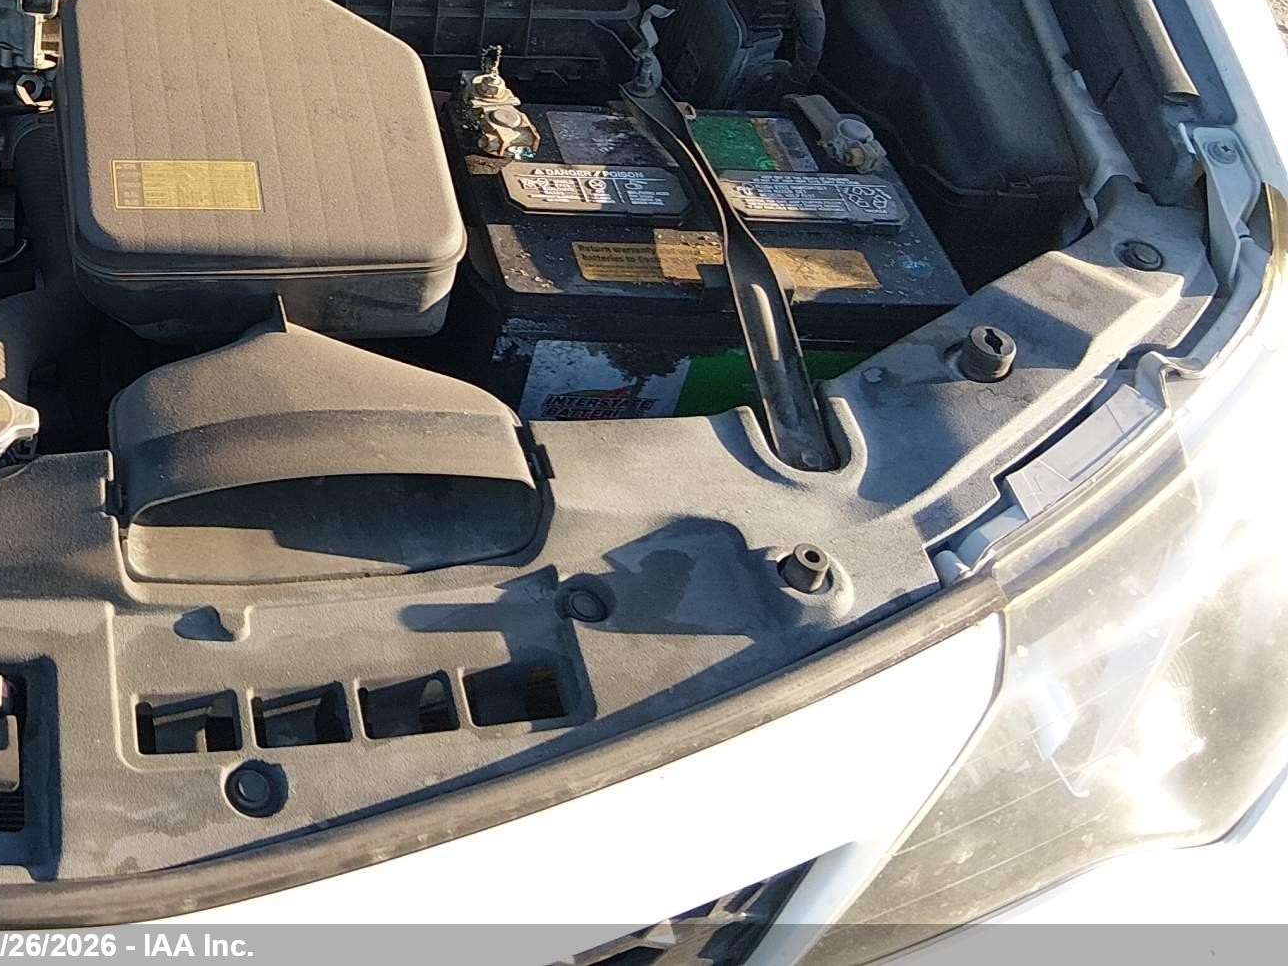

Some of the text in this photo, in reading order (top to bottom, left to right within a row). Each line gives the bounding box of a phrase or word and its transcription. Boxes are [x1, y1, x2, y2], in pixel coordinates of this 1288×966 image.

[544, 168, 592, 177] DANGER
[602, 170, 644, 179] POISON
[578, 244, 612, 253] Return
[582, 254, 625, 264] batteries
[543, 396, 655, 410] INTERSTAE
